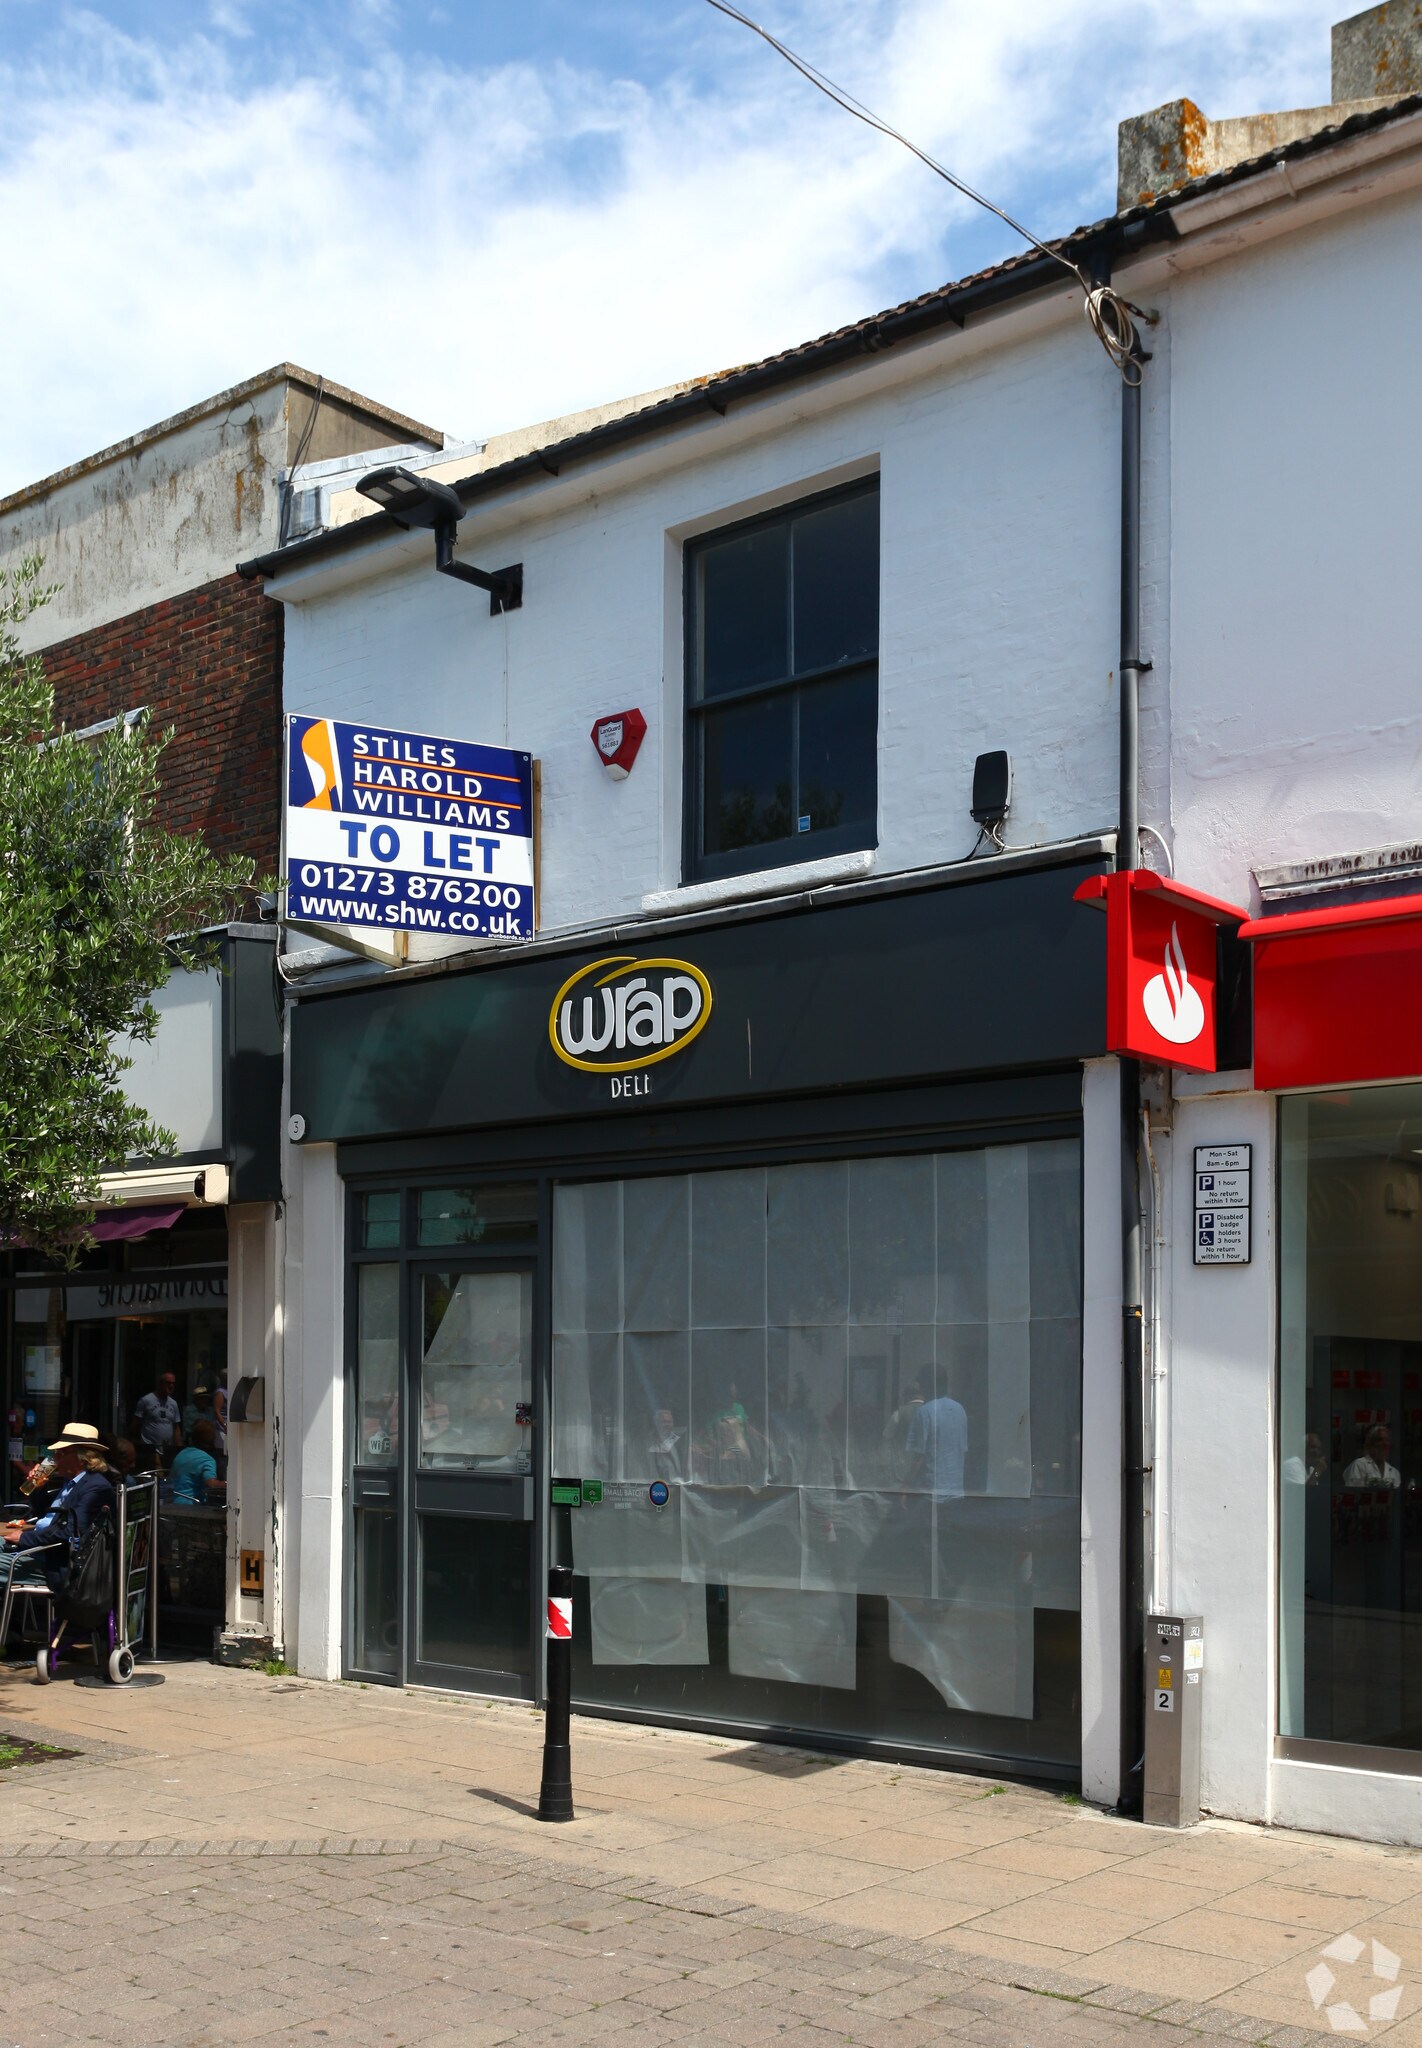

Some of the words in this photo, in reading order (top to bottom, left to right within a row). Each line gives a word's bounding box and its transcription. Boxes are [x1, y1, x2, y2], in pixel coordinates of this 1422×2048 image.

[353, 734, 456, 768] STILES
[354, 762, 482, 798] HAROLD
[353, 789, 510, 830] WILLIAMS
[340, 820, 400, 862] TO
[424, 831, 500, 874] LET
[301, 864, 395, 896] 01273
[407, 876, 521, 910] 876200
[300, 896, 521, 936] www.shw.co.uk
[560, 976, 702, 1054] wrap
[611, 1074, 650, 1098] DELI
[294, 1121, 299, 1133] 3
[246, 1557, 260, 1582] H
[1159, 1693, 1169, 1708] 2
